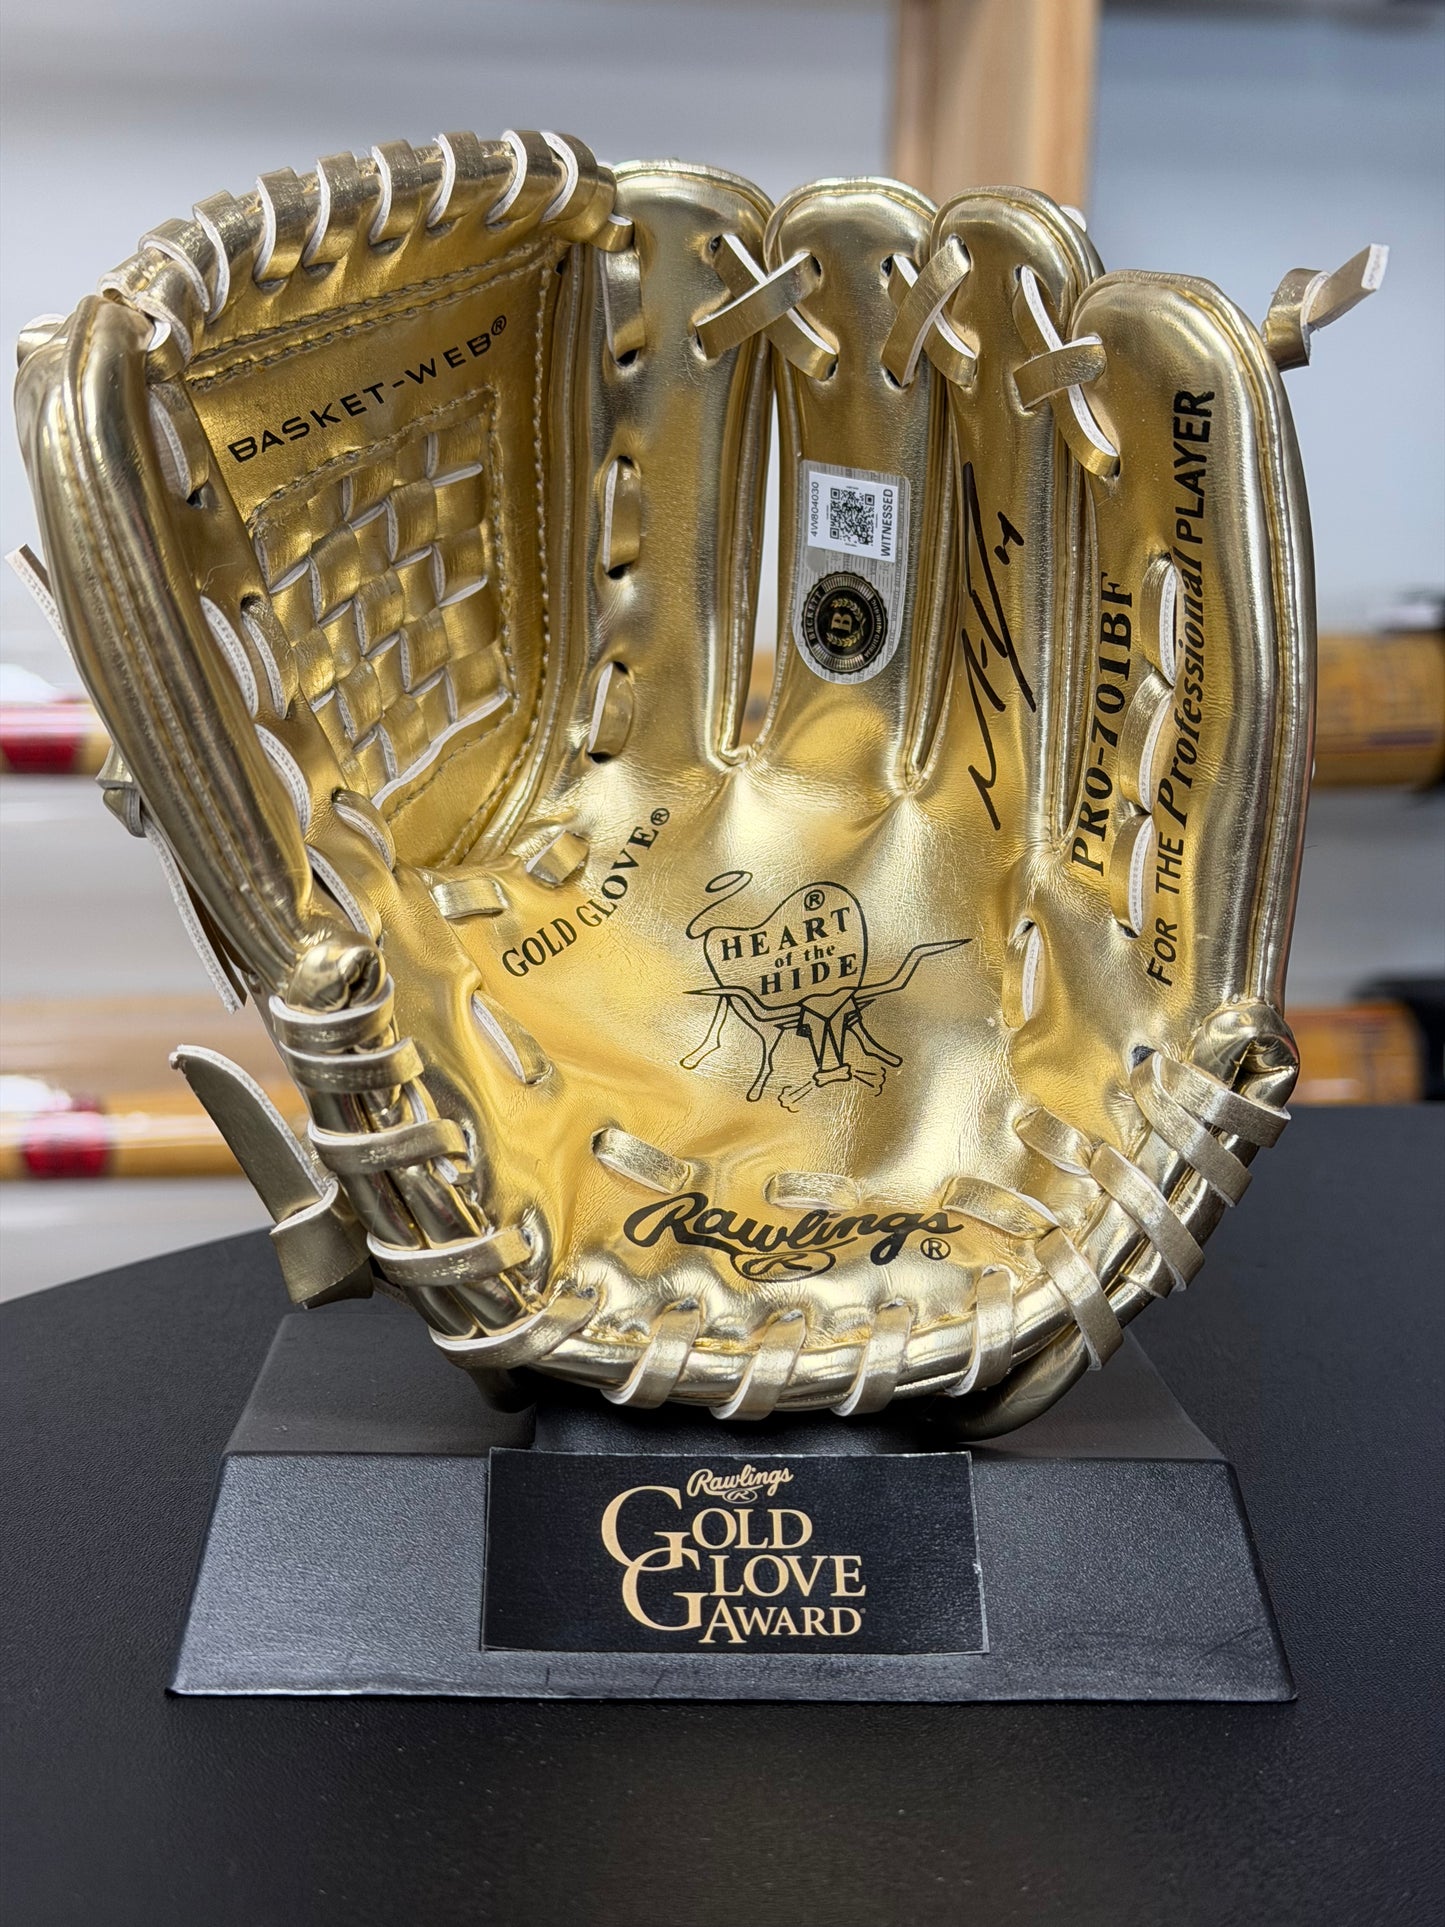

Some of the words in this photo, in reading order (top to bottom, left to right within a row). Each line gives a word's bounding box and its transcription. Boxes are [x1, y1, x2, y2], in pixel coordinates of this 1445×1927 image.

[1172, 389, 1215, 545] PLAYER
[811, 481, 820, 537] 4W804030
[881, 488, 894, 557] WITNESSED
[807, 590, 822, 641] BECKETT
[831, 612, 852, 633] B
[1157, 546, 1205, 831] Professional
[1071, 571, 1133, 877] PRO-701BF
[1155, 831, 1184, 895] THE
[501, 917, 578, 978] GOLD
[720, 907, 850, 961] HEART
[774, 952, 792, 968] of
[804, 945, 835, 962] the
[1146, 917, 1178, 987] FOR
[759, 953, 858, 996] HIDE
[623, 1192, 964, 1266] Rawlings
[686, 1464, 794, 1498] Rawlings
[601, 1485, 813, 1572] GOLD
[621, 1546, 867, 1631] GLOVE
[698, 1597, 863, 1644] AWARD
